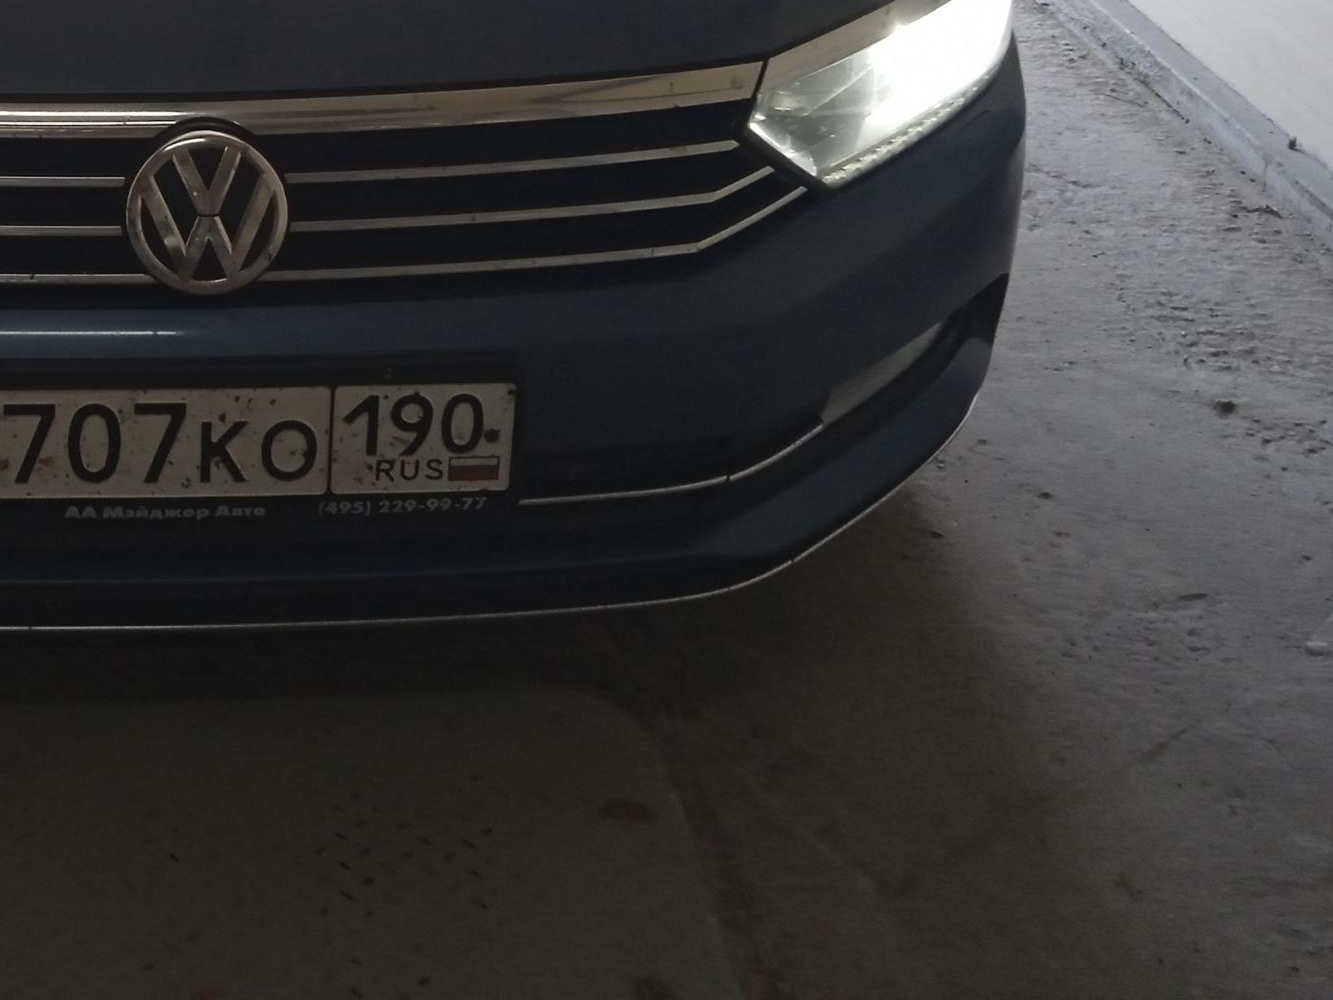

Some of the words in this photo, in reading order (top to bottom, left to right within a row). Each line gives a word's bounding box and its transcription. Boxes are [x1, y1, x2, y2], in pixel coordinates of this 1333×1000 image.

[342, 393, 484, 457] 190
[374, 458, 444, 482] RUS
[65, 505, 97, 519] АА
[102, 503, 210, 521] Мэйджор
[215, 503, 267, 517] Авто
[317, 499, 371, 516] (495)
[378, 495, 488, 514] 229-99-77
